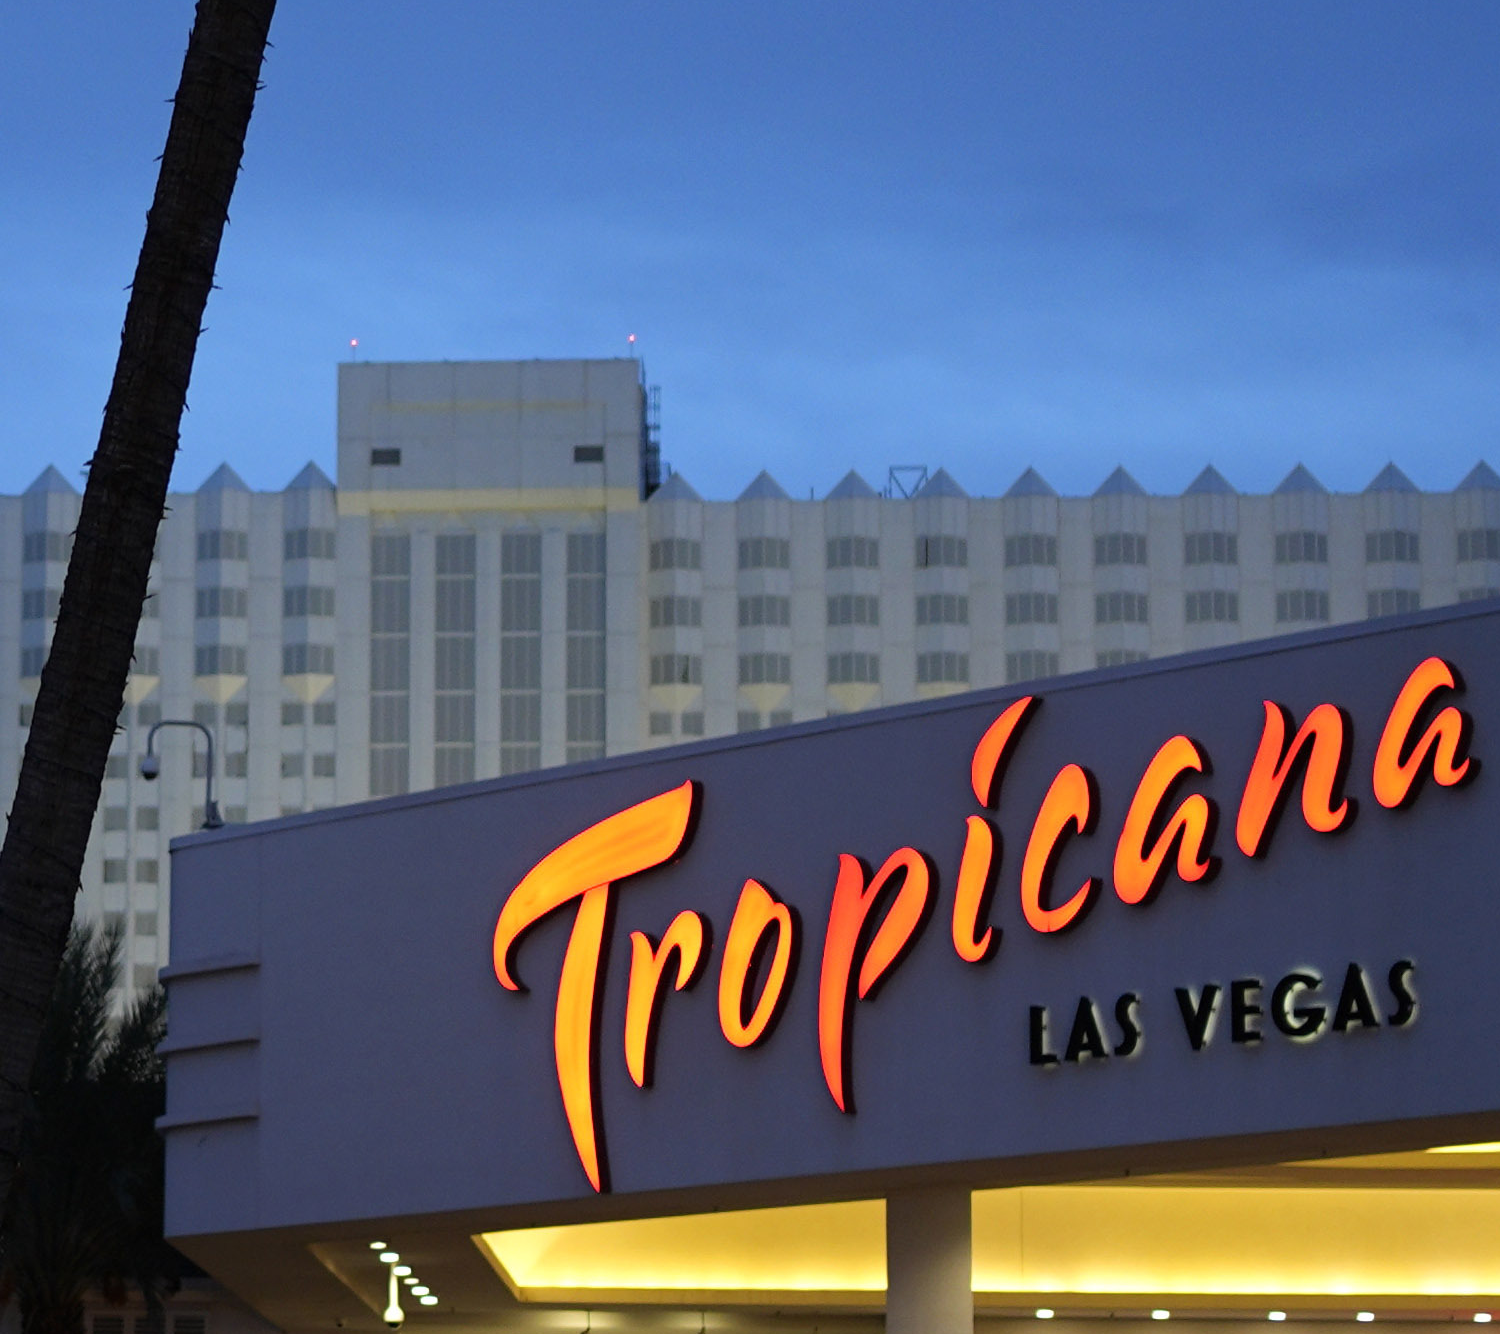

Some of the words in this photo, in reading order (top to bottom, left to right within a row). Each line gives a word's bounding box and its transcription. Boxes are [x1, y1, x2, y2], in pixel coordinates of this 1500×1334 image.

[492, 655, 1481, 1194] Tropicana
[1028, 992, 1144, 1067] LAS
[1174, 958, 1419, 1051] VEGAS
